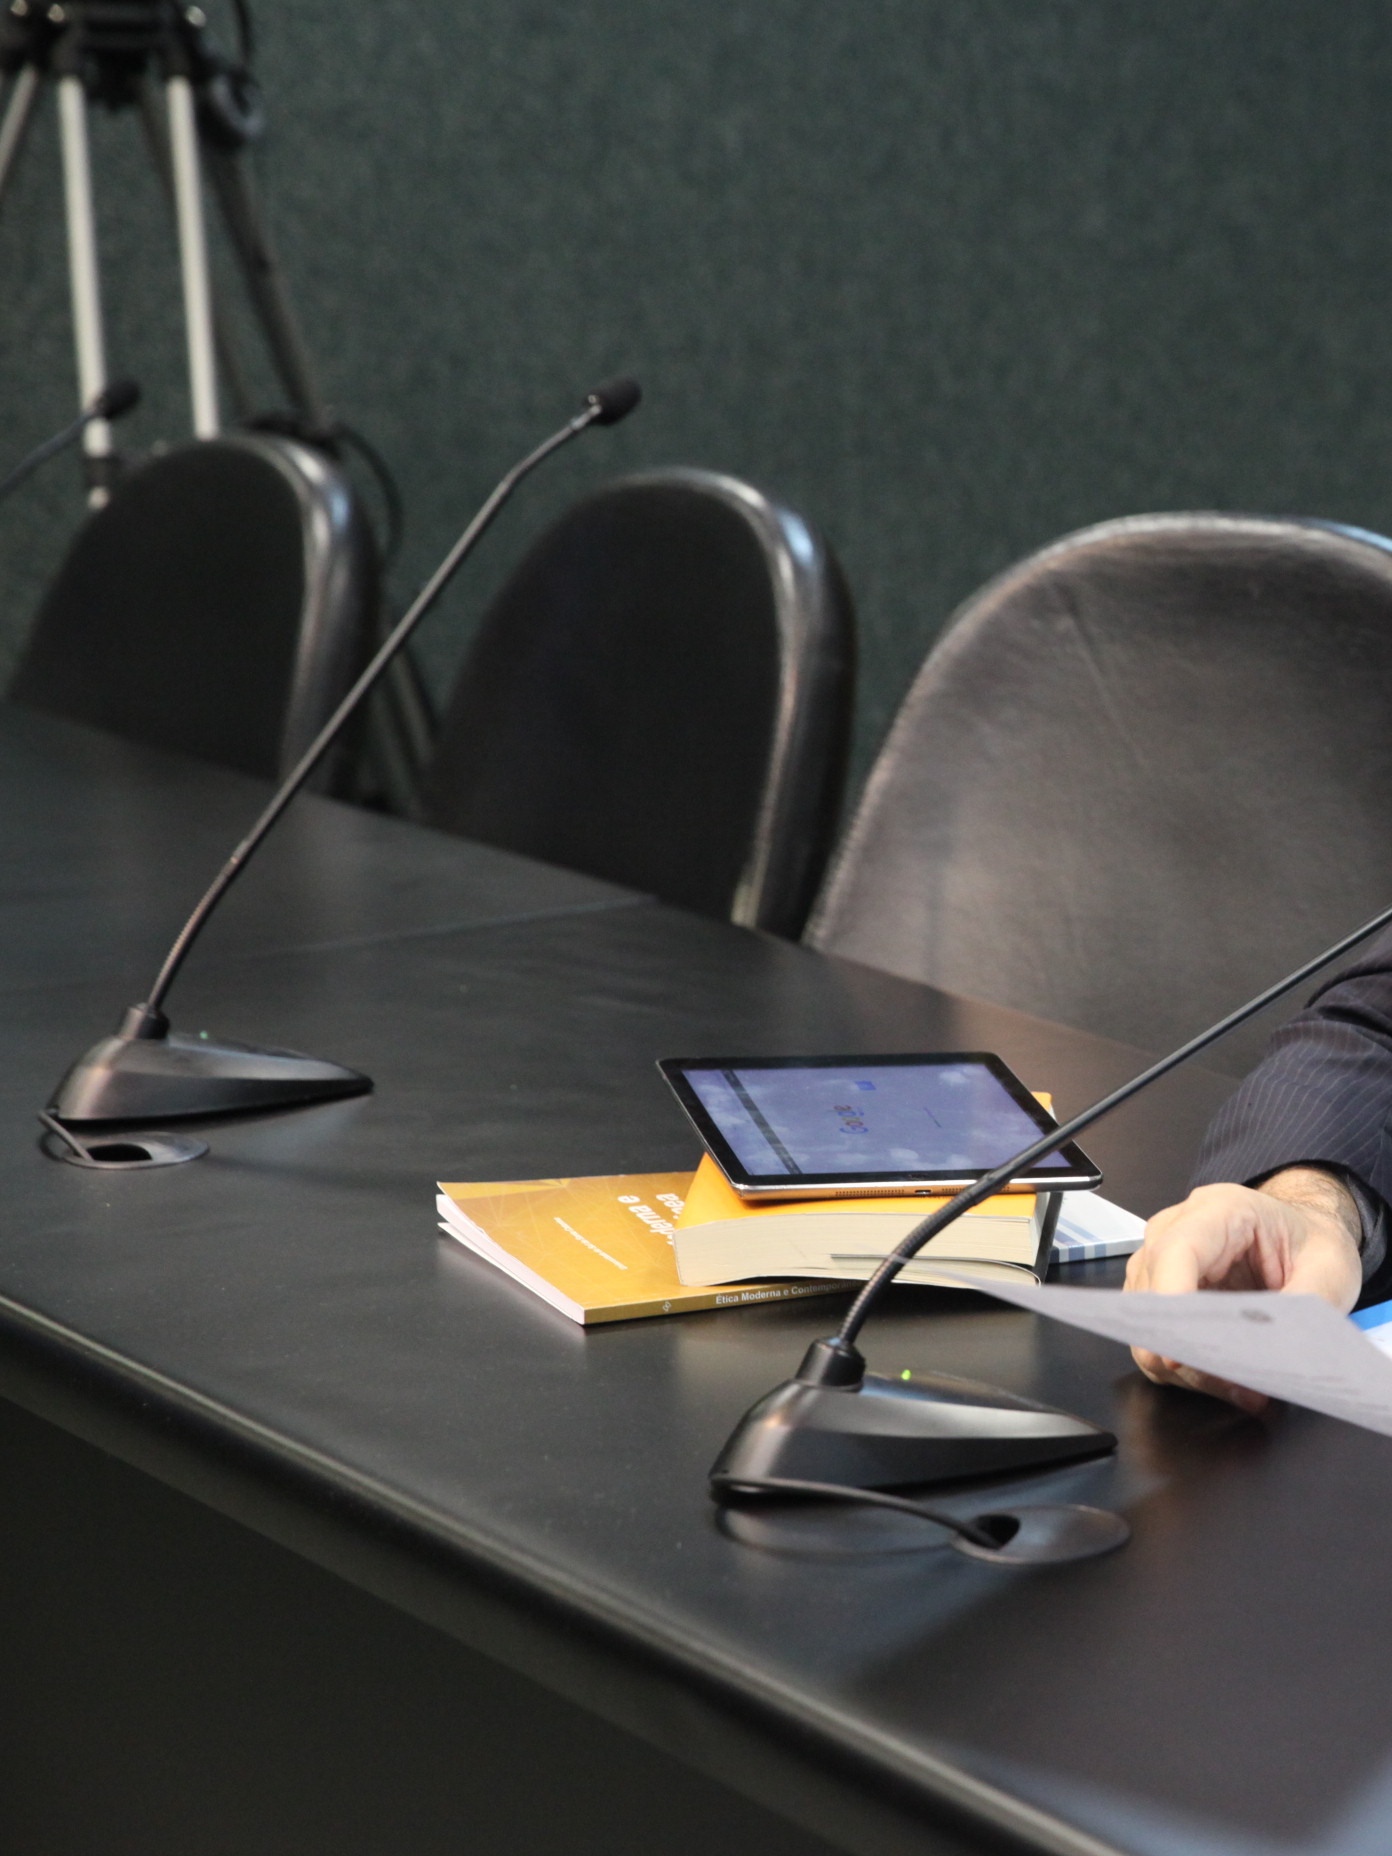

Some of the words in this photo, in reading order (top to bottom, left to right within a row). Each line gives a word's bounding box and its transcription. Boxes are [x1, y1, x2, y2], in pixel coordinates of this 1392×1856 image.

[715, 1292, 739, 1305] Ética
[741, 1289, 781, 1301] Moderna
[783, 1287, 789, 1296] e
